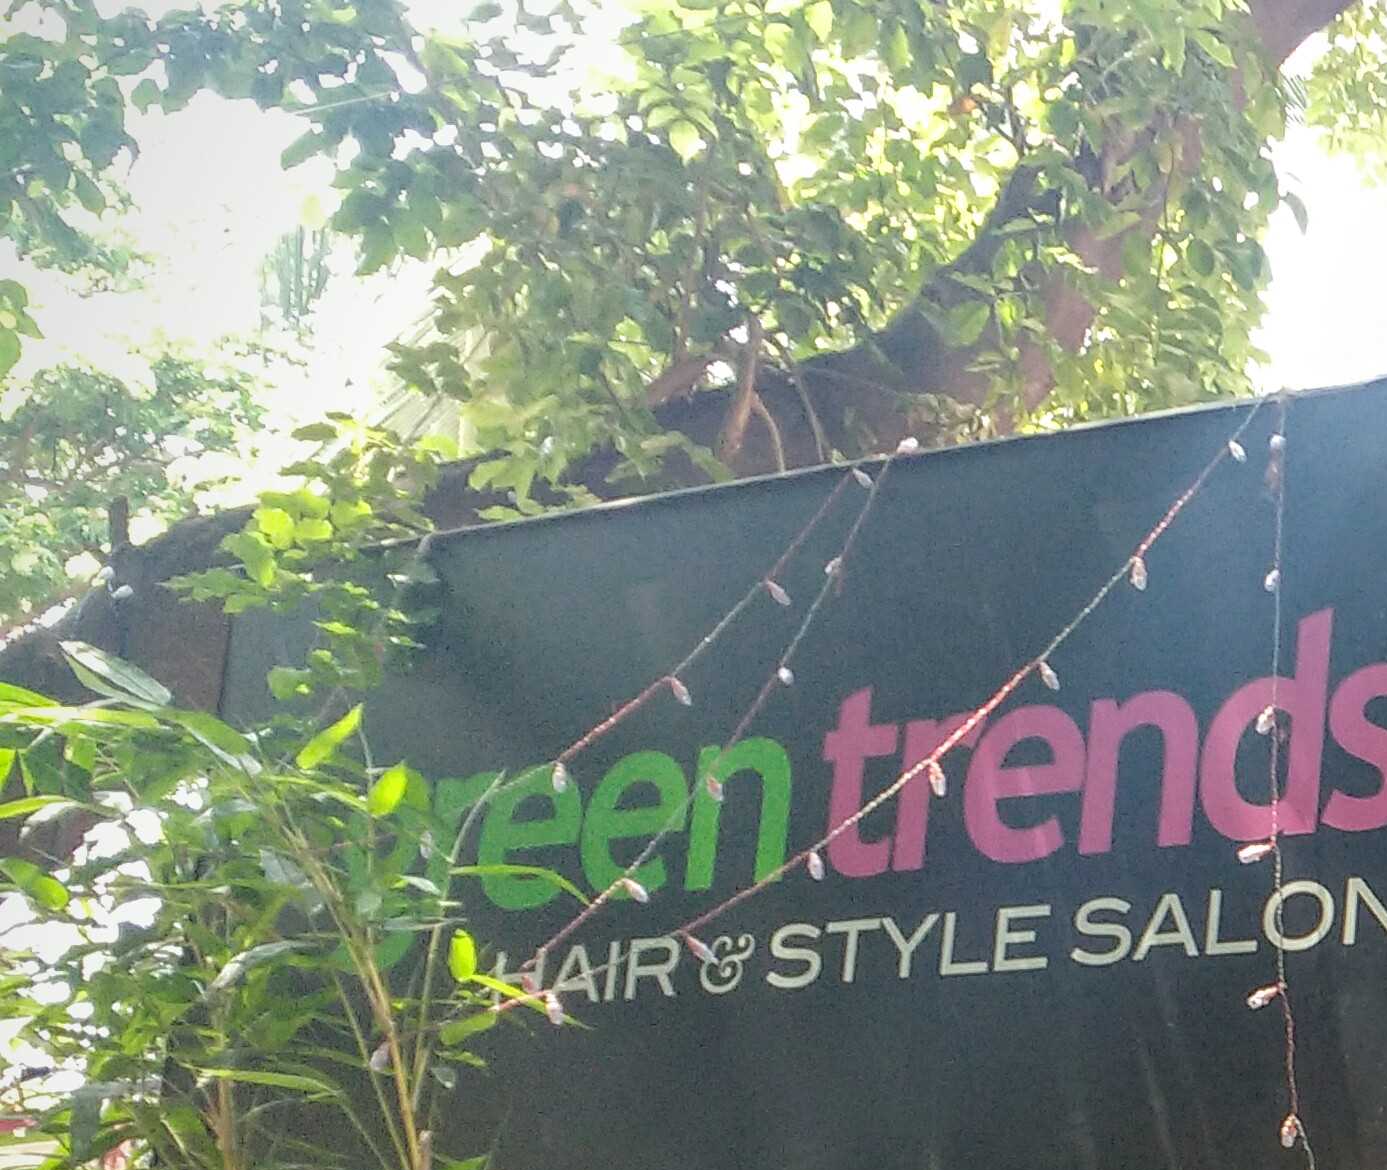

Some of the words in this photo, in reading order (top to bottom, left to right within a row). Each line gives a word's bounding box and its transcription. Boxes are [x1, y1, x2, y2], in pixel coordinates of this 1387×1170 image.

[495, 936, 681, 1006] HAIR
[700, 933, 756, 994] &
[765, 904, 1052, 990] STYLE
